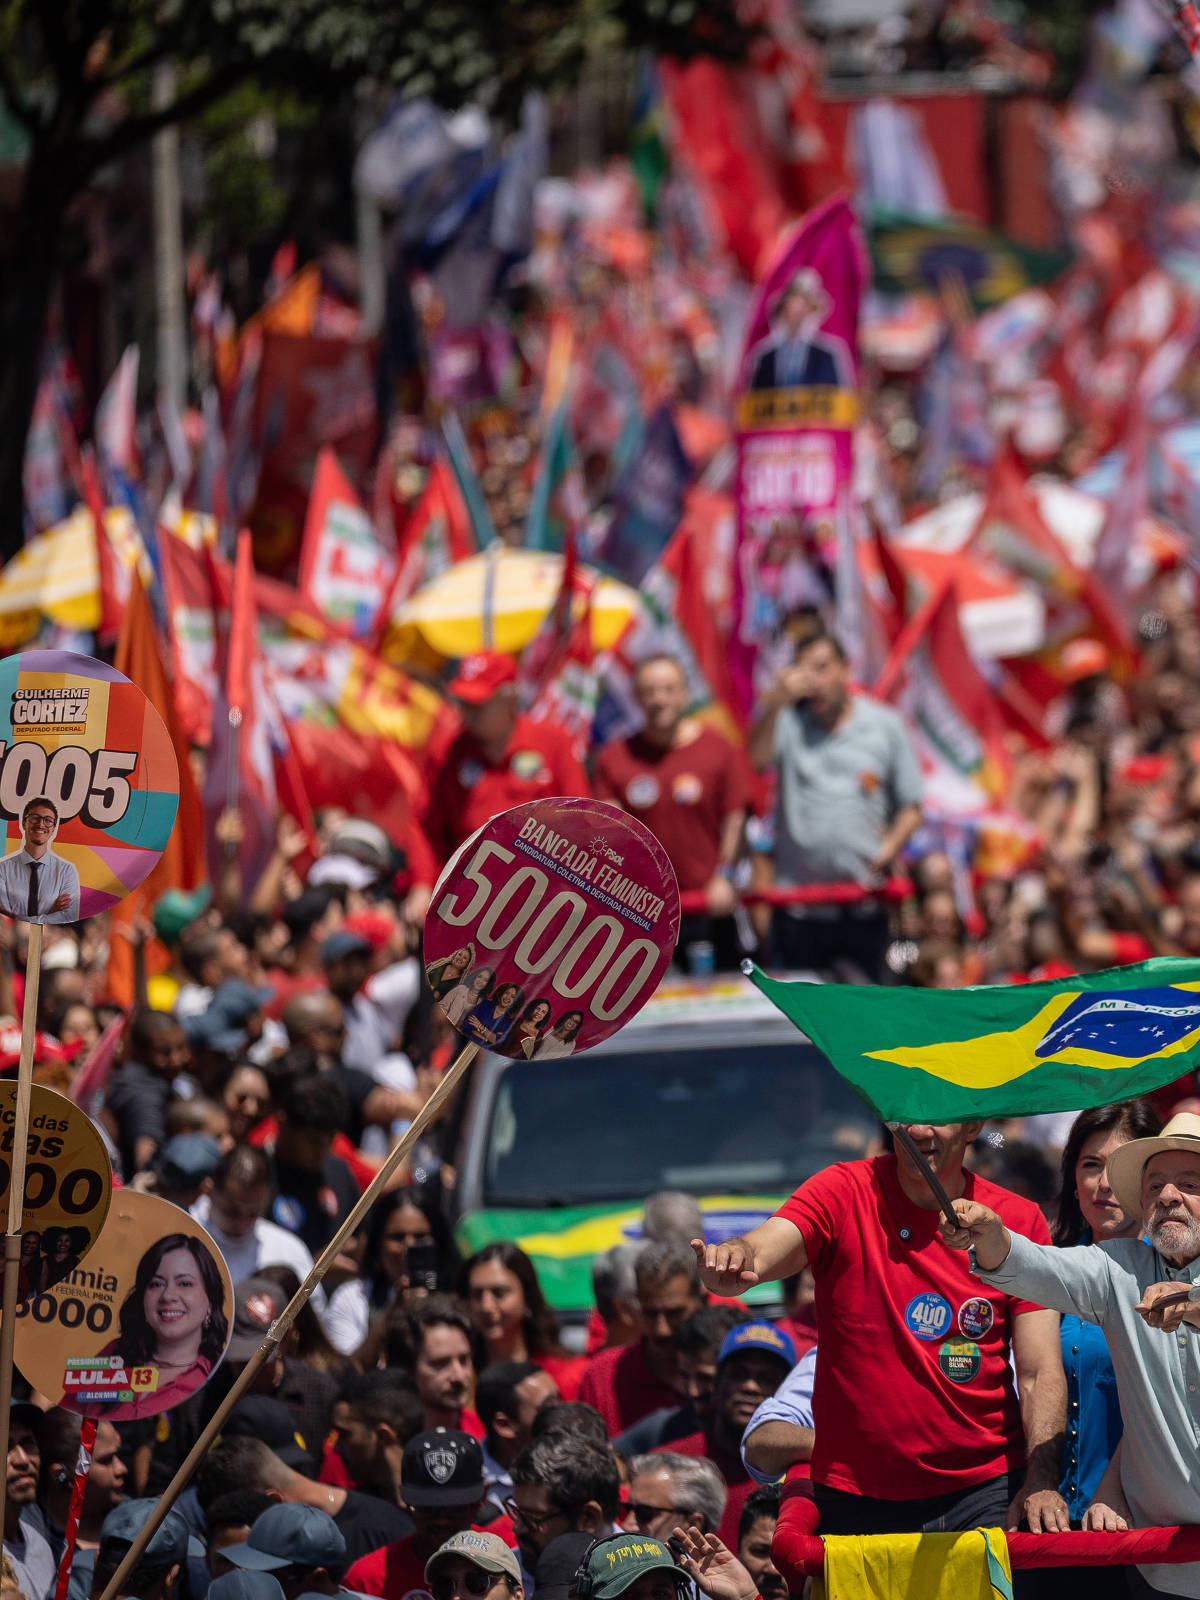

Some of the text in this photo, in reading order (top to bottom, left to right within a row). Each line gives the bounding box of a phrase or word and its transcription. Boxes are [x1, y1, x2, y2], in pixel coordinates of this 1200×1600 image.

[14, 688, 90, 700] GUILHERME
[12, 699, 89, 724] CORTEZ
[16, 726, 51, 734] DEPUTADO
[0, 741, 138, 824] 005
[518, 817, 598, 880] BANCADA
[514, 839, 558, 870] CANDIDATURA
[557, 867, 586, 889] COLETIVA
[590, 887, 622, 913] DEPUTADA
[620, 907, 652, 930] ESTADUAL
[437, 840, 660, 1021] 50000
[33, 1114, 69, 1132] das
[56, 1287, 114, 1303] FEDERAL PSOL
[947, 1341, 974, 1355] 180
[65, 1369, 152, 1385] LULA 13
[425, 1452, 456, 1467] NETS
